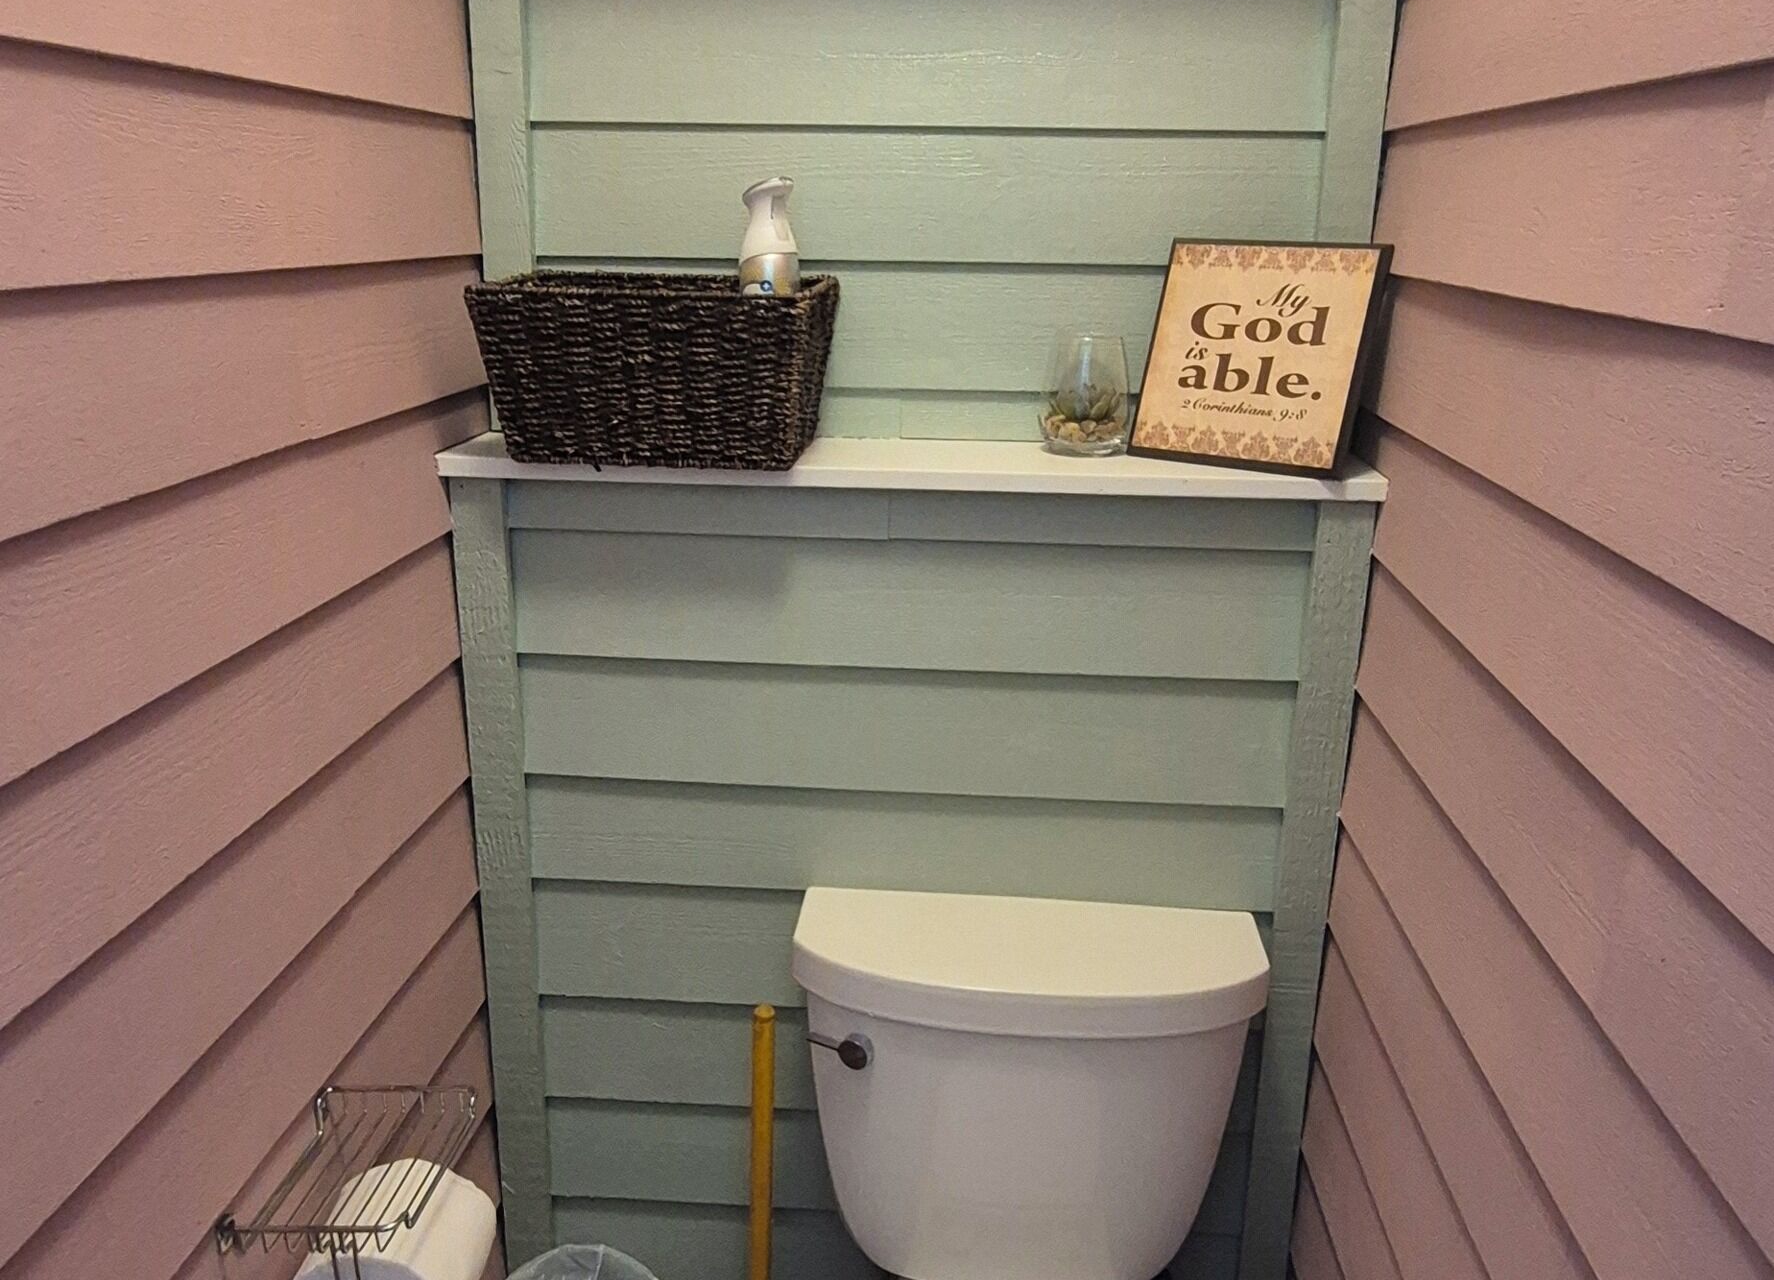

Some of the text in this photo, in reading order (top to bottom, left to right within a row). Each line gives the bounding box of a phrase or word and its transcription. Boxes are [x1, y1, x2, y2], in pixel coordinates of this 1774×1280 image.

[1256, 283, 1311, 318] My
[1191, 302, 1330, 347] God
[1185, 340, 1208, 361] is
[1178, 353, 1321, 401] able.
[1181, 398, 1191, 409] 2
[1279, 408, 1307, 422] 9:8
